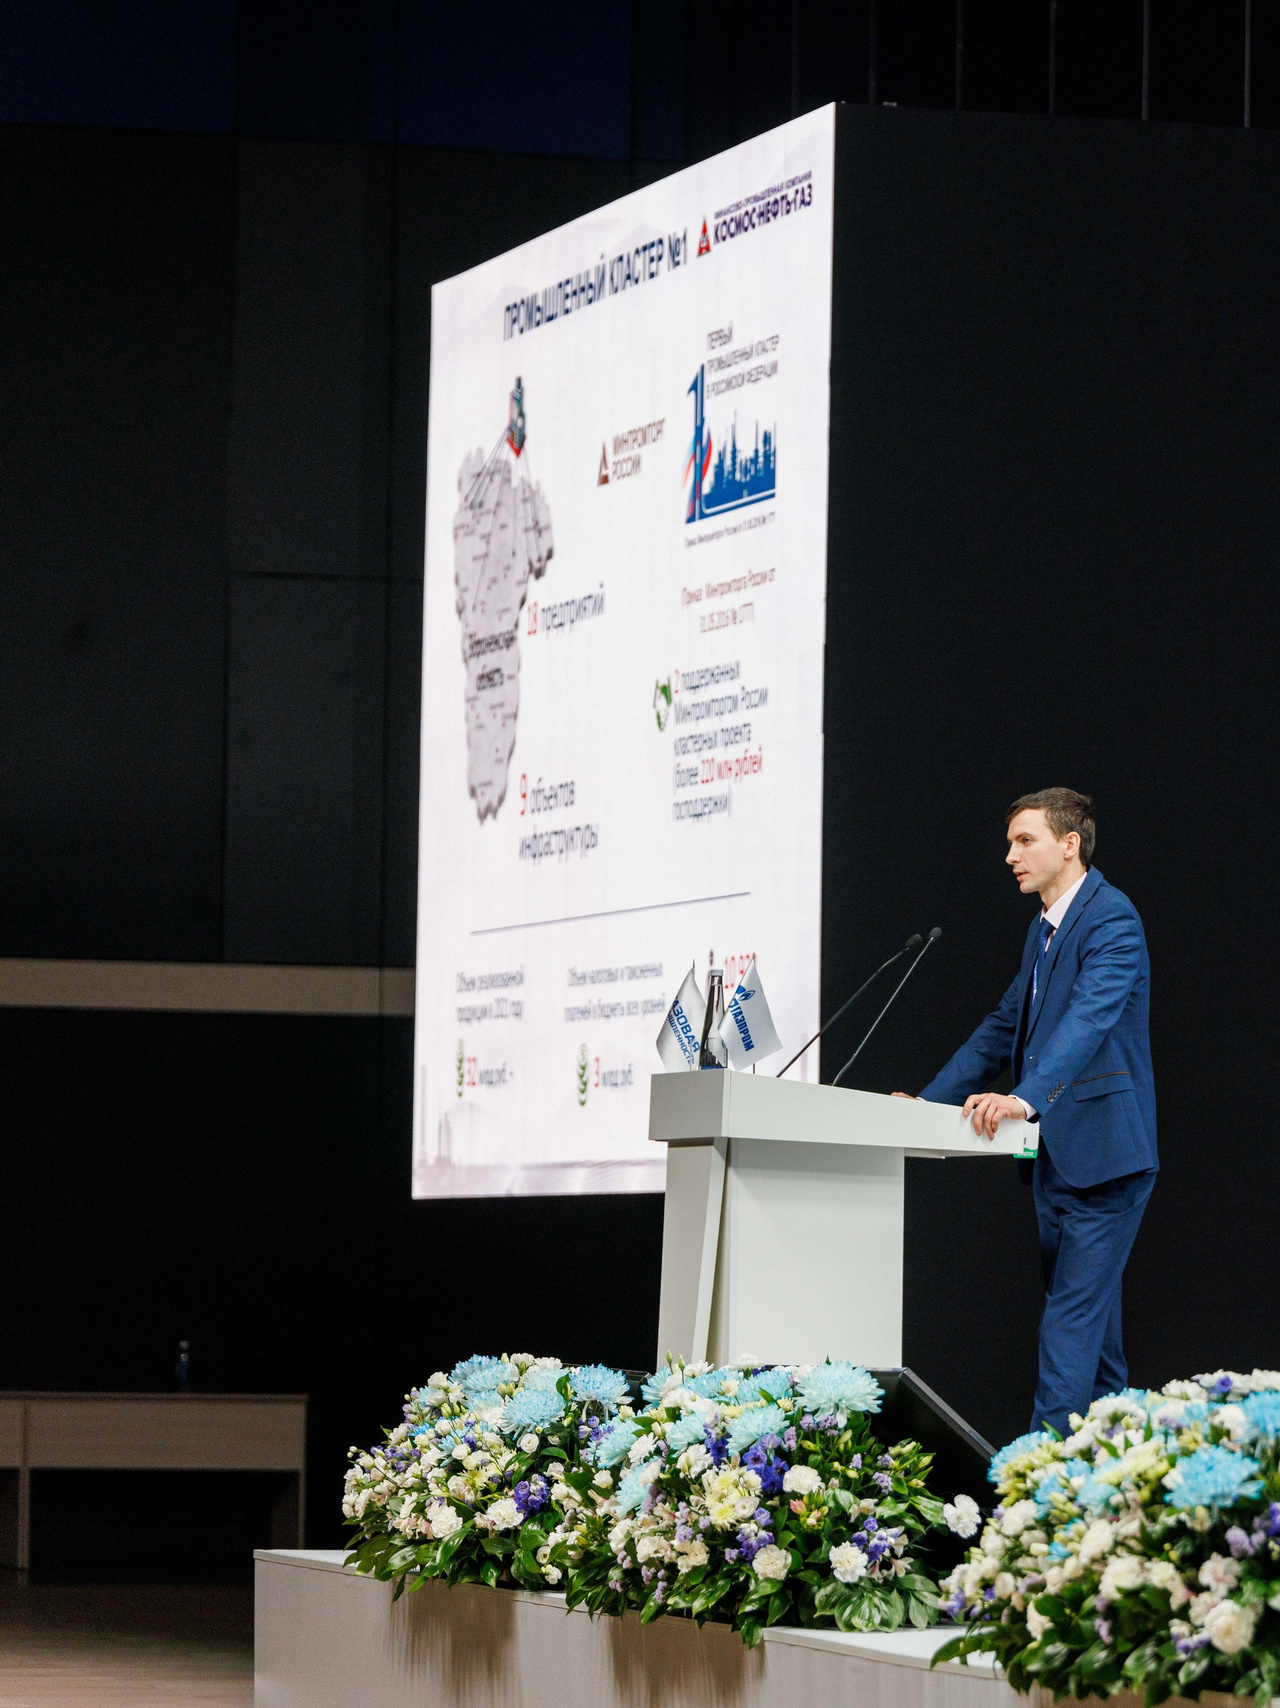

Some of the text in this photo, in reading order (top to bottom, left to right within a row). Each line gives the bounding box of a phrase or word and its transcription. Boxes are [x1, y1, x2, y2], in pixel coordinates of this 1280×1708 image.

[503, 254, 606, 342] ПРОМЫШЛЕННЫЙ
[608, 237, 664, 297] КЛАСТЕР
[706, 320, 733, 351] ПЕРВЫЙ
[612, 418, 666, 456] МИНПРОМТОРГ
[612, 452, 641, 480] РОССИИ
[541, 580, 604, 636] предприятий
[681, 660, 740, 693] поддержанных
[674, 686, 768, 727] Минпромторгом России
[674, 722, 751, 757] кластерных проекта
[700, 757, 715, 784] 220
[717, 759, 732, 780] млн
[734, 745, 763, 783] рублей
[520, 773, 575, 816] 9 объектов
[519, 823, 598, 865] инфраструктуры
[672, 996, 701, 1053] АЗОВАЯ
[731, 1005, 755, 1052] ГАЗПРОМ
